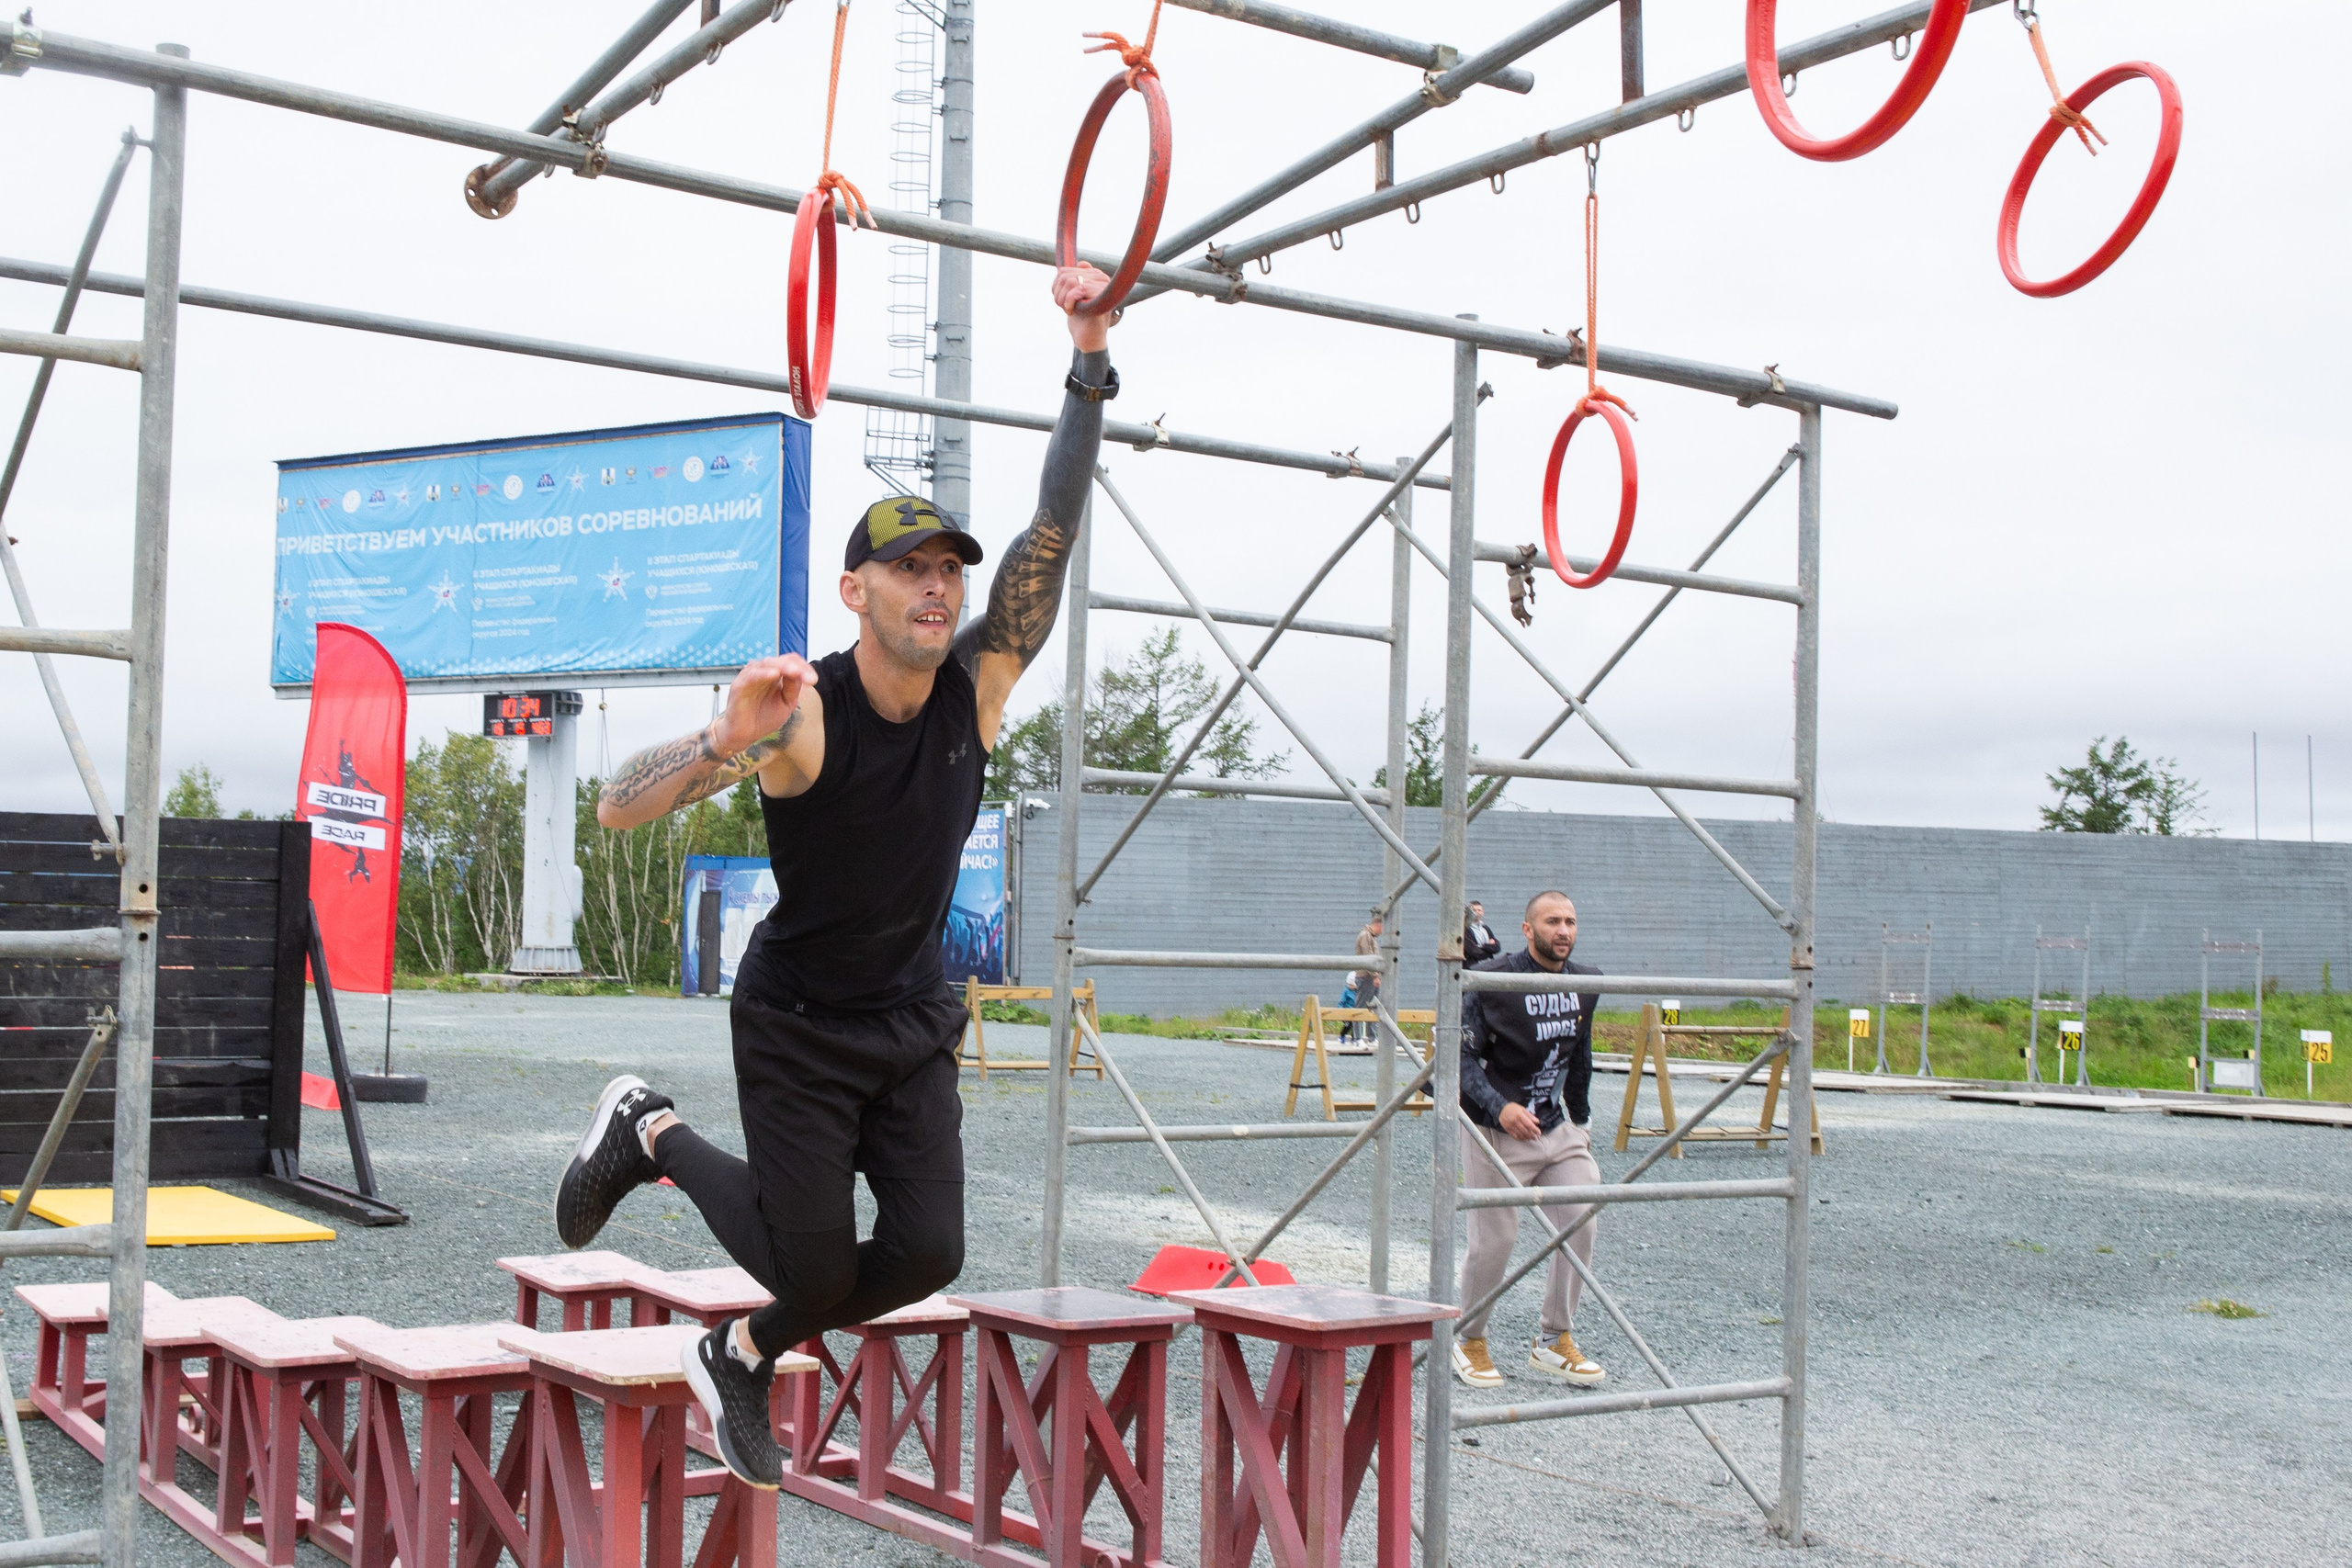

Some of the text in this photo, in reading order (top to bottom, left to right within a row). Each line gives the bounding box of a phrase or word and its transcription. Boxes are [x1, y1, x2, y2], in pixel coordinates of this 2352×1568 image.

[277, 491, 763, 556] ПРИВЕТСТВУЕМ УЧАСТНИКОВ СОРЕВНОВАНИЙ
[977, 813, 1001, 832] ЩЕЕ
[964, 833, 1000, 850] АЕТСЯ
[960, 852, 999, 870] ЙЧАС!»
[1524, 991, 1580, 1018] СУДЬЯ
[1664, 1009, 1679, 1025] 28
[1535, 1019, 1577, 1042] JUDGE
[1852, 1019, 1866, 1036] 27
[2064, 1032, 2080, 1051] 26
[2311, 1042, 2328, 1062] 25
[1532, 1088, 1551, 1097] RAC
